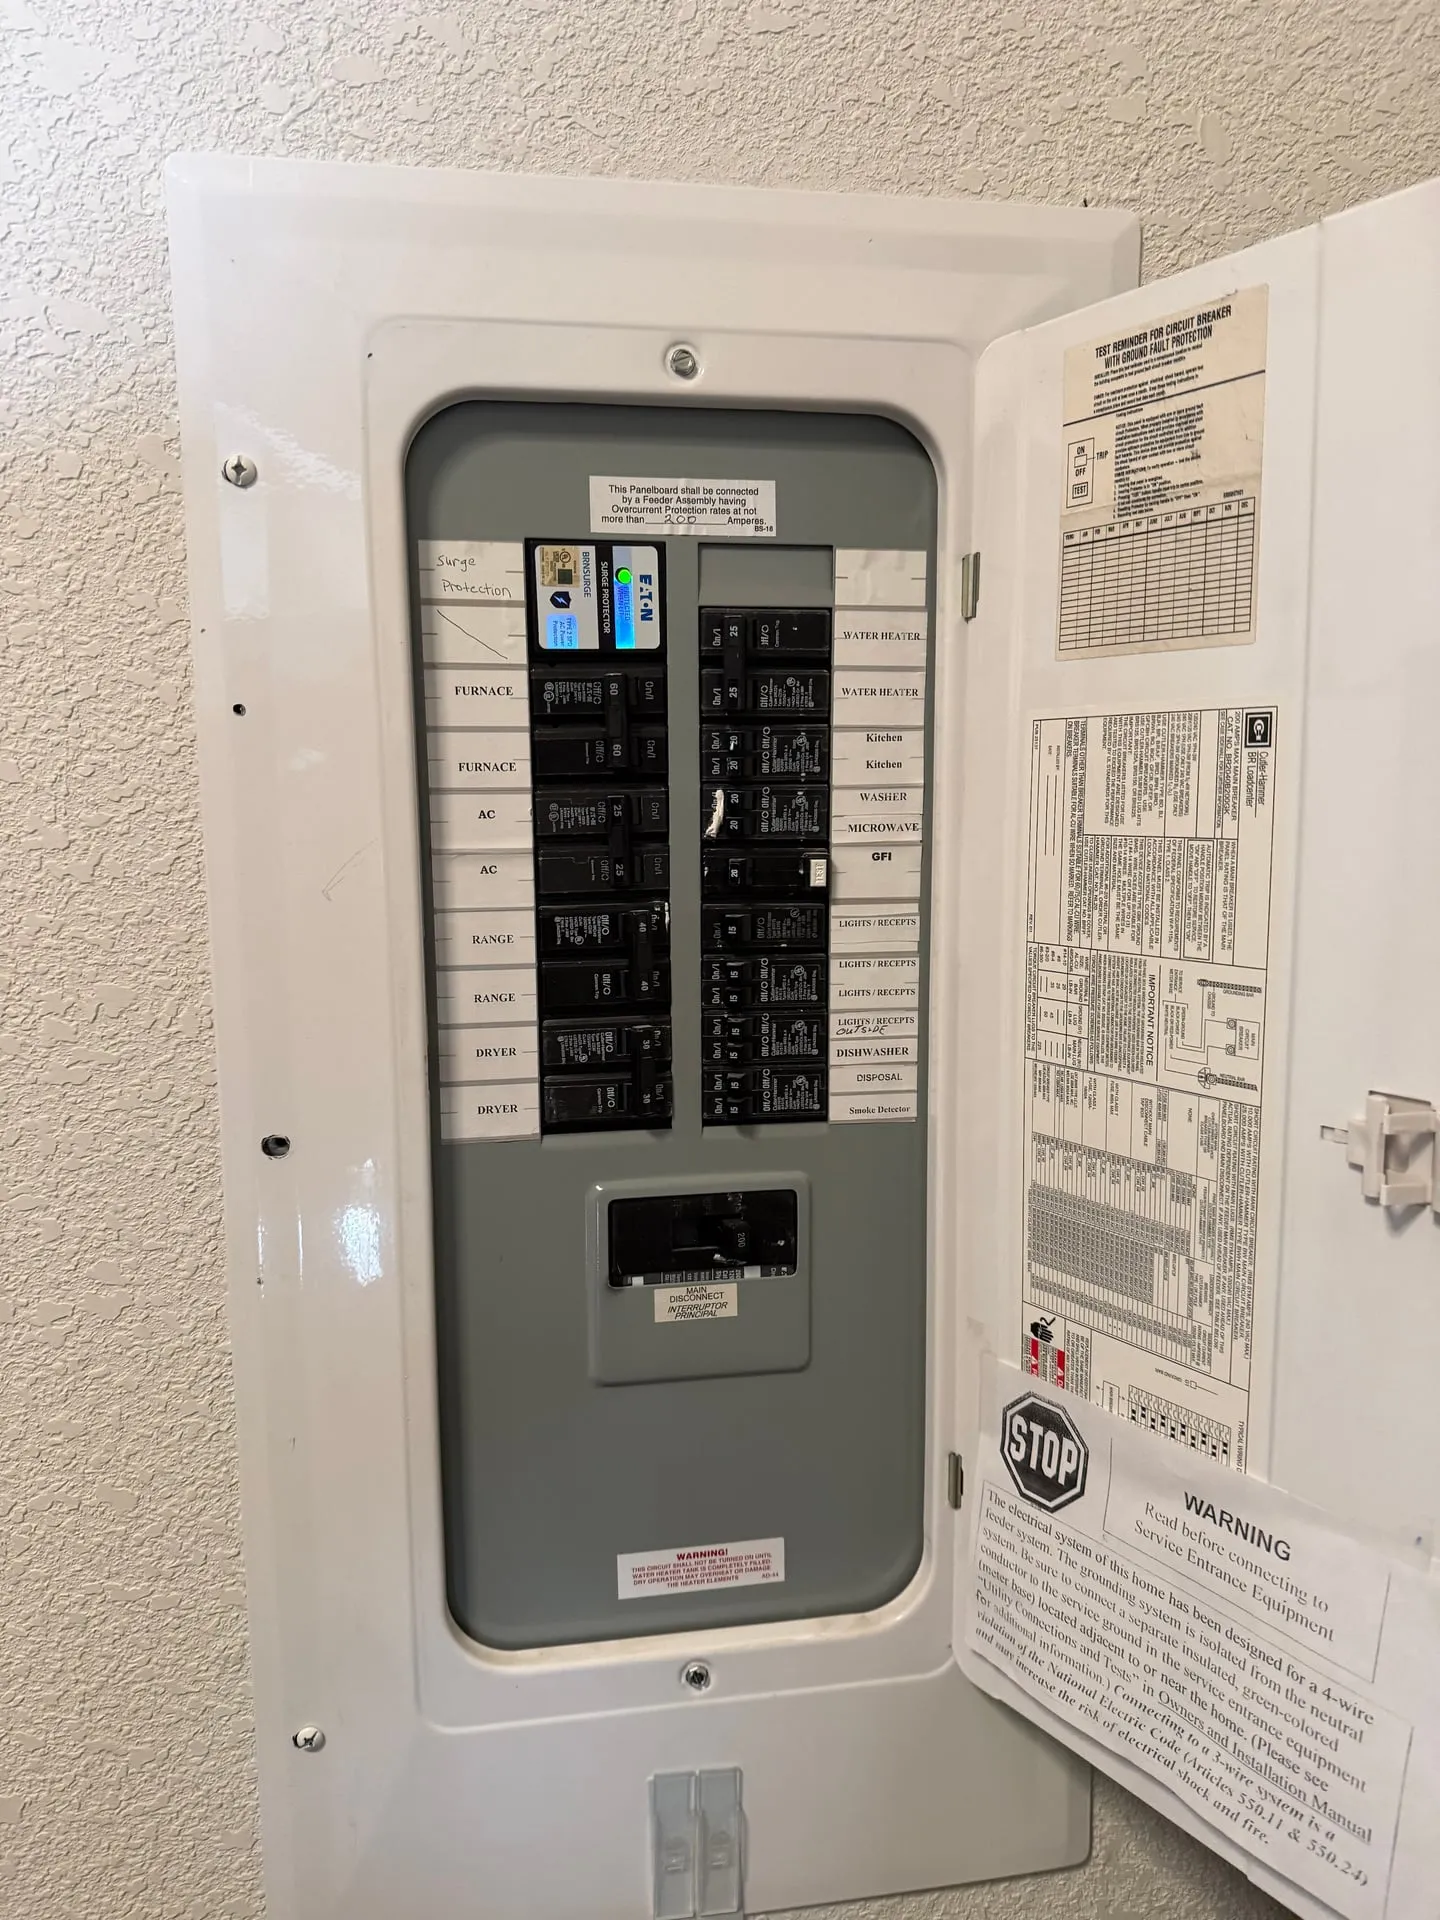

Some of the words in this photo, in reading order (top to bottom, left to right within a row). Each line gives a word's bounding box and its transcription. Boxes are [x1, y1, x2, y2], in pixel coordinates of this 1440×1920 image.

[1096, 345, 1111, 358] TEST
[1113, 332, 1147, 353] REMINDER
[1150, 327, 1163, 341] FOR
[1166, 317, 1194, 337] CIRCUIT
[1197, 305, 1232, 327] BREAKER
[1105, 355, 1120, 369] WITH
[1122, 346, 1148, 363] GROUND
[1150, 338, 1170, 356] FAULT
[1171, 325, 1213, 349] PROTECTION
[1077, 446, 1085, 454] ON
[1096, 450, 1108, 460] TRIP
[1076, 467, 1086, 477] OFF
[609, 485, 627, 493] This
[630, 486, 678, 495] Panelboard
[681, 486, 700, 495] shall
[703, 487, 713, 495] be
[716, 487, 759, 495] connected
[1074, 485, 1086, 495] TEST
[622, 495, 632, 504] by
[643, 496, 669, 504] Feeder
[676, 496, 715, 506] Assembly
[718, 497, 746, 506] having
[612, 505, 662, 513] Overcurrent
[665, 506, 706, 514] Protection
[710, 507, 730, 515] rates
[733, 507, 741, 515] at
[744, 507, 757, 515] not
[626, 515, 644, 523] than
[664, 514, 696, 524] 200
[727, 517, 767, 525] Amperes.
[437, 555, 476, 572] Surge
[582, 552, 591, 598] BRNSURGE
[600, 562, 608, 588] SURGE
[442, 579, 511, 598] Protection
[640, 575, 652, 621] EATON
[601, 589, 610, 633] PROTECTOR
[730, 626, 737, 637] 25
[843, 632, 879, 640] WATER
[881, 632, 920, 640] HEATER
[455, 686, 513, 696] FURNACE
[610, 683, 618, 695] 60
[729, 687, 737, 698] 25
[842, 688, 877, 696] WATER
[879, 688, 918, 696] HEATER
[866, 734, 902, 742] Kitchen
[613, 744, 621, 756] 60
[1247, 752, 1257, 764] BR
[458, 763, 516, 772] FURNACE
[866, 760, 902, 768] Kitchen
[1257, 751, 1269, 806] Cutler-Hammer
[731, 794, 739, 803] 20
[860, 793, 907, 801] WASHER
[478, 810, 496, 819] AC
[614, 805, 622, 817] 25
[848, 823, 919, 832] MICROWAVE
[872, 852, 891, 860] GFI
[480, 865, 497, 874] AC
[616, 864, 623, 876] 25
[640, 923, 646, 932] 40
[728, 926, 736, 934] 15
[472, 934, 514, 944] RANGE
[839, 960, 871, 968] LIGHTS
[474, 993, 515, 1003] RANGE
[839, 989, 871, 997] LIGHTS
[1148, 974, 1156, 1031] IMPORTANT
[643, 1040, 650, 1049] 30
[476, 1047, 516, 1057] DRYER
[837, 1047, 909, 1057] DISHWASHER
[857, 1073, 902, 1081] DISPOSAL
[477, 1104, 518, 1114] DRYER
[670, 1292, 724, 1303] DISCONNECT
[668, 1302, 728, 1313] INTERRUPTOR
[675, 1310, 717, 1320] PRINCIPAL
[1010, 1414, 1078, 1485] STOP
[1184, 1491, 1290, 1561] WARNING
[677, 1548, 728, 1560] WARNING!
[1146, 1502, 1178, 1531] Read
[1182, 1522, 1224, 1555] before
[1229, 1551, 1307, 1605] connecting
[1313, 1595, 1328, 1612] to
[647, 1564, 671, 1572] CIRCUIT
[719, 1556, 743, 1564] TURNED
[1134, 1520, 1183, 1556] Service
[1187, 1547, 1247, 1592] Entrance
[1252, 1584, 1334, 1642] Equipment
[988, 1490, 1006, 1508] The
[1008, 1503, 1051, 1536] electrical
[1055, 1531, 1091, 1558] system
[1095, 1552, 1108, 1566] of
[1110, 1558, 1129, 1579] this
[1132, 1571, 1165, 1599] home
[1169, 1592, 1189, 1613] has
[1193, 1605, 1222, 1633] been
[1225, 1627, 1282, 1671] designed
[1286, 1664, 1306, 1686] for
[1309, 1683, 1317, 1694] a
[1322, 1687, 1374, 1725] 4-wire
[986, 1508, 1015, 1533] feeder
[1017, 1529, 1052, 1557] system.
[1057, 1549, 1078, 1569] The
[1080, 1566, 1136, 1607] grounding
[1139, 1598, 1181, 1631] system
[1185, 1622, 1195, 1638] is
[1200, 1631, 1245, 1671] isolated
[1250, 1665, 1281, 1694] from
[1285, 1686, 1306, 1709] the
[1310, 1704, 1363, 1744] neutral
[979, 1559, 1010, 1586] (meter
[1012, 1579, 1035, 1606] base)
[1038, 1597, 1077, 1629] located
[1080, 1623, 1125, 1659] adjacent
[1128, 1649, 1140, 1667] to
[1143, 1663, 1157, 1677] or
[1160, 1671, 1187, 1696] near
[1190, 1688, 1208, 1710] the
[1211, 1704, 1248, 1741] home.
[1251, 1733, 1300, 1774] (Please
[1304, 1771, 1329, 1792] see
